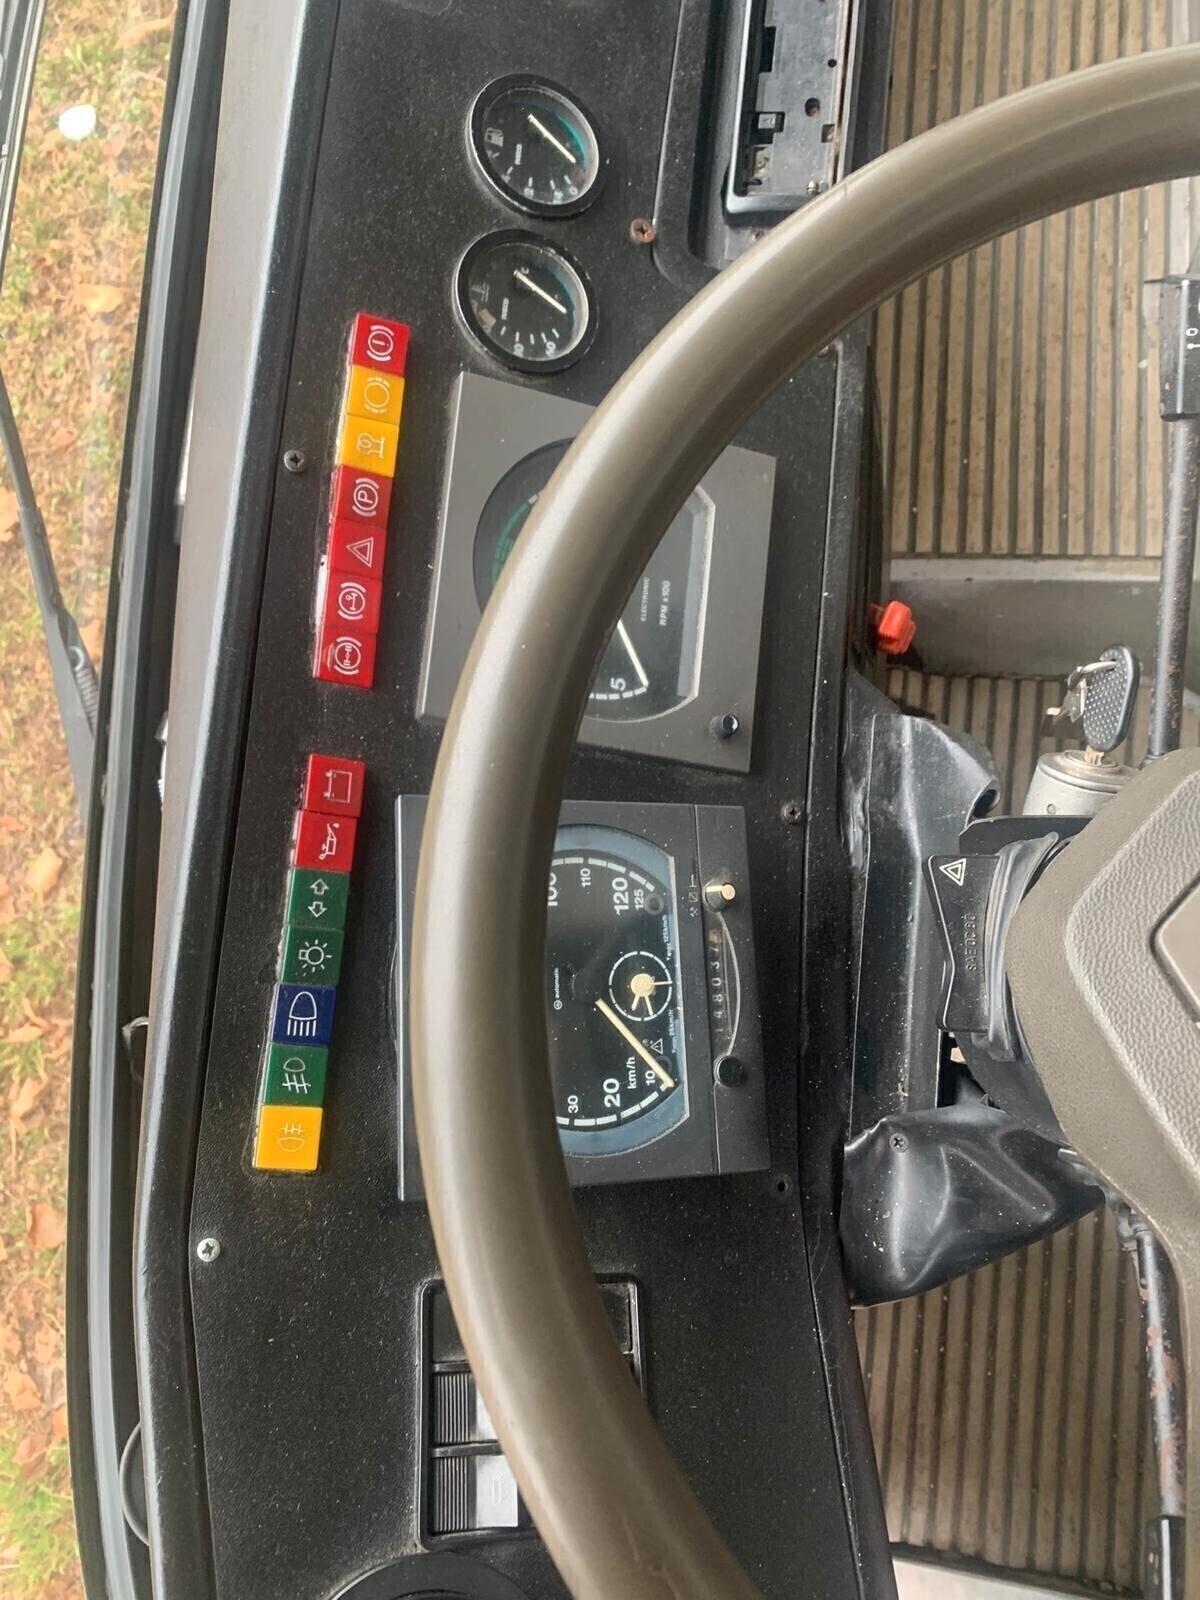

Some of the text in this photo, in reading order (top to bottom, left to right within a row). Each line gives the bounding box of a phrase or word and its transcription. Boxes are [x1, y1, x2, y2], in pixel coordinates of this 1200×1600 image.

[640, 576, 650, 622] ELECTRONIC
[659, 605, 669, 626] RPM
[610, 677, 626, 691] 5
[580, 868, 591, 888] 110
[611, 877, 629, 916] 120
[634, 889, 644, 910] 125
[964, 948, 977, 971] SAE
[708, 928, 724, 1033] 148037
[626, 1057, 637, 1089] km/h
[645, 1070, 656, 1086] 10
[602, 1078, 621, 1108] 20
[567, 1095, 579, 1114] 30
